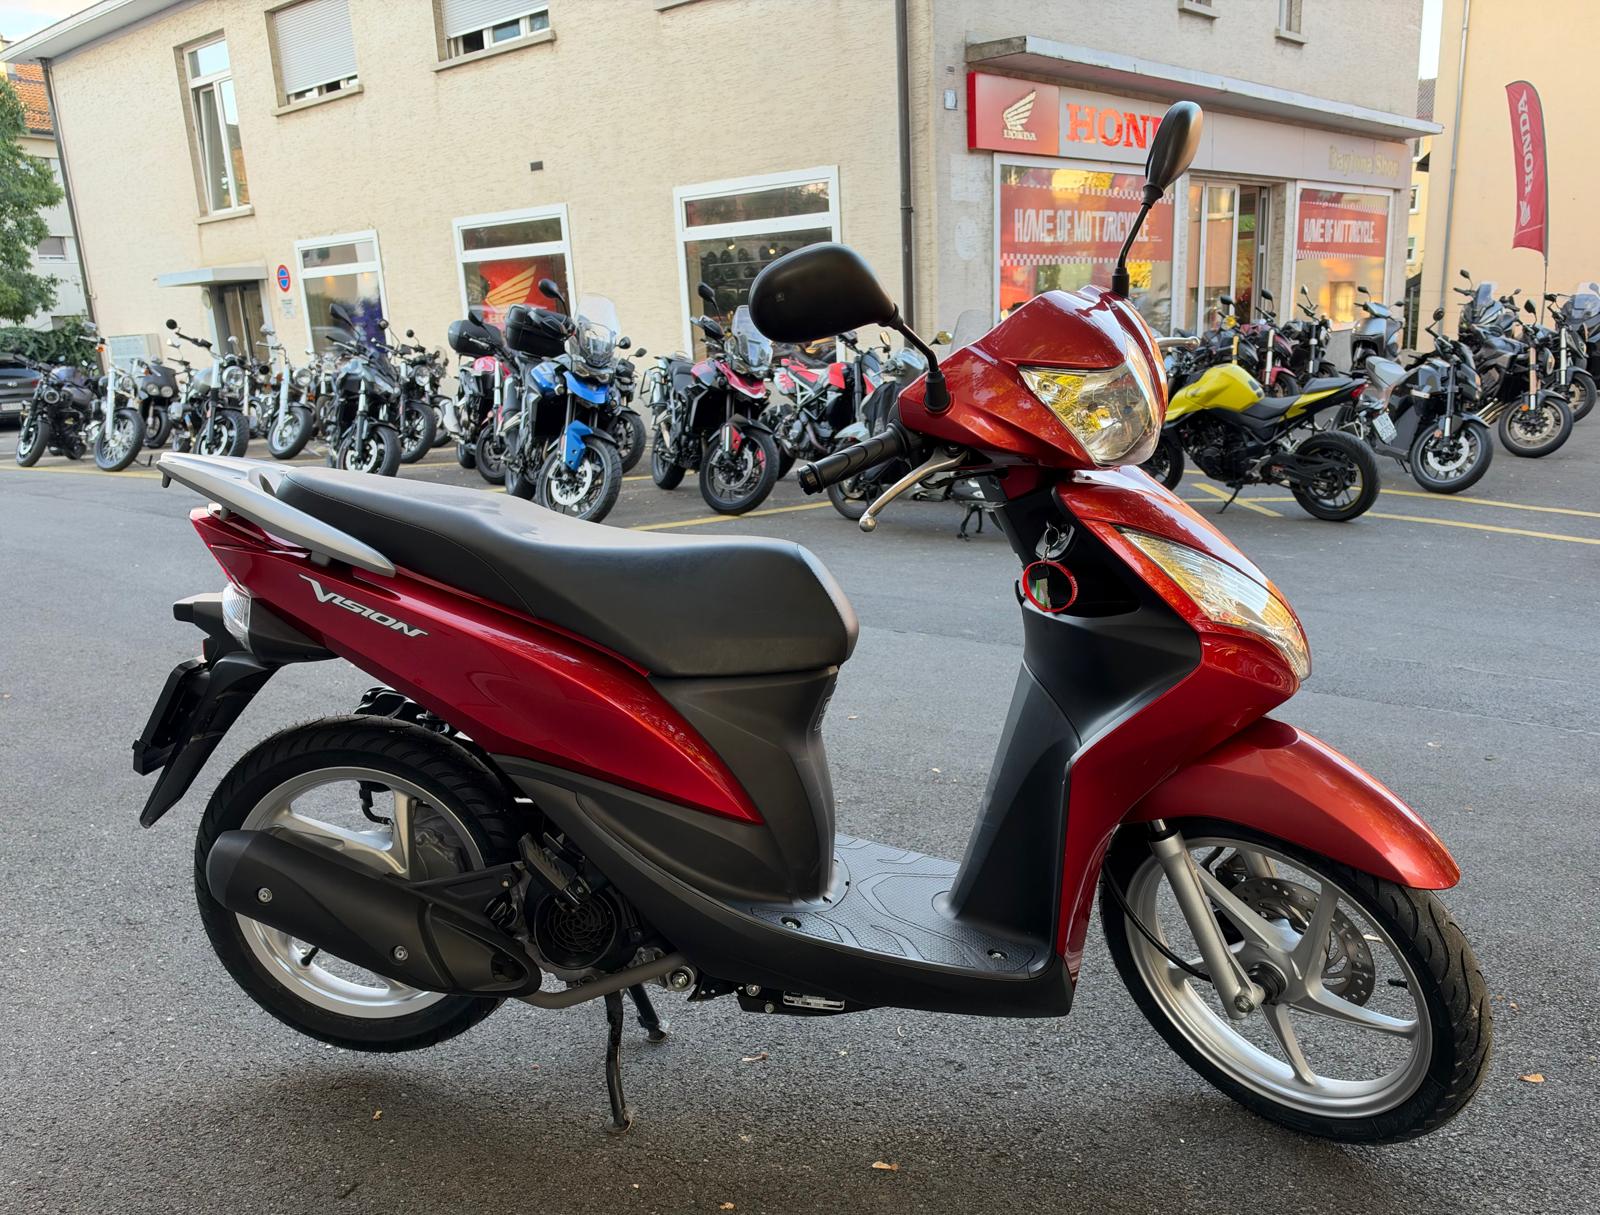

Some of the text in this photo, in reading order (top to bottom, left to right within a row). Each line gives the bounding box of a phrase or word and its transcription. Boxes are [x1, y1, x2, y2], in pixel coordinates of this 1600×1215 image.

[1003, 129, 1037, 141] HONDA
[1518, 89, 1534, 195] HONDA
[1014, 208, 1054, 243] HOME
[1056, 209, 1072, 243] OF
[299, 573, 428, 637] VISION
